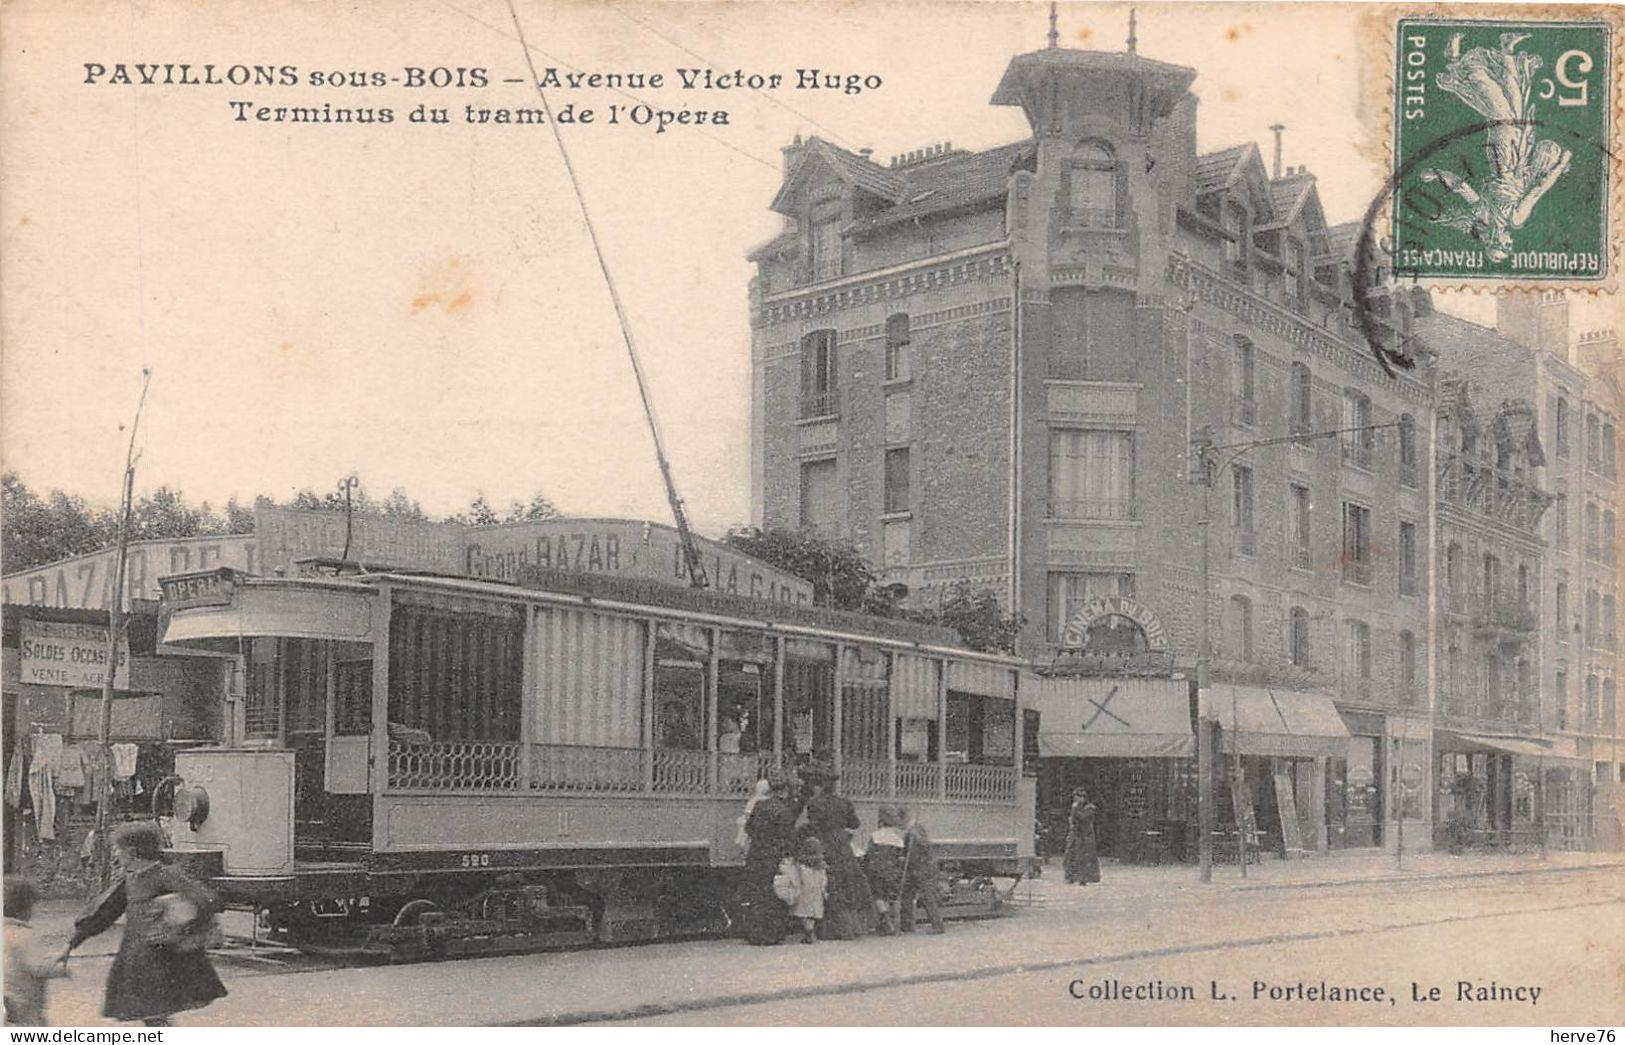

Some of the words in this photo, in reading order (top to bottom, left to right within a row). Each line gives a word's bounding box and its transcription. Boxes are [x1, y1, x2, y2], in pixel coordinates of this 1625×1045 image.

[1406, 35, 1425, 120] POSTES
[1403, 250, 1483, 269] FRANÇAISE
[537, 534, 620, 571] BAZAR
[72, 646, 126, 668] OCCASIS
